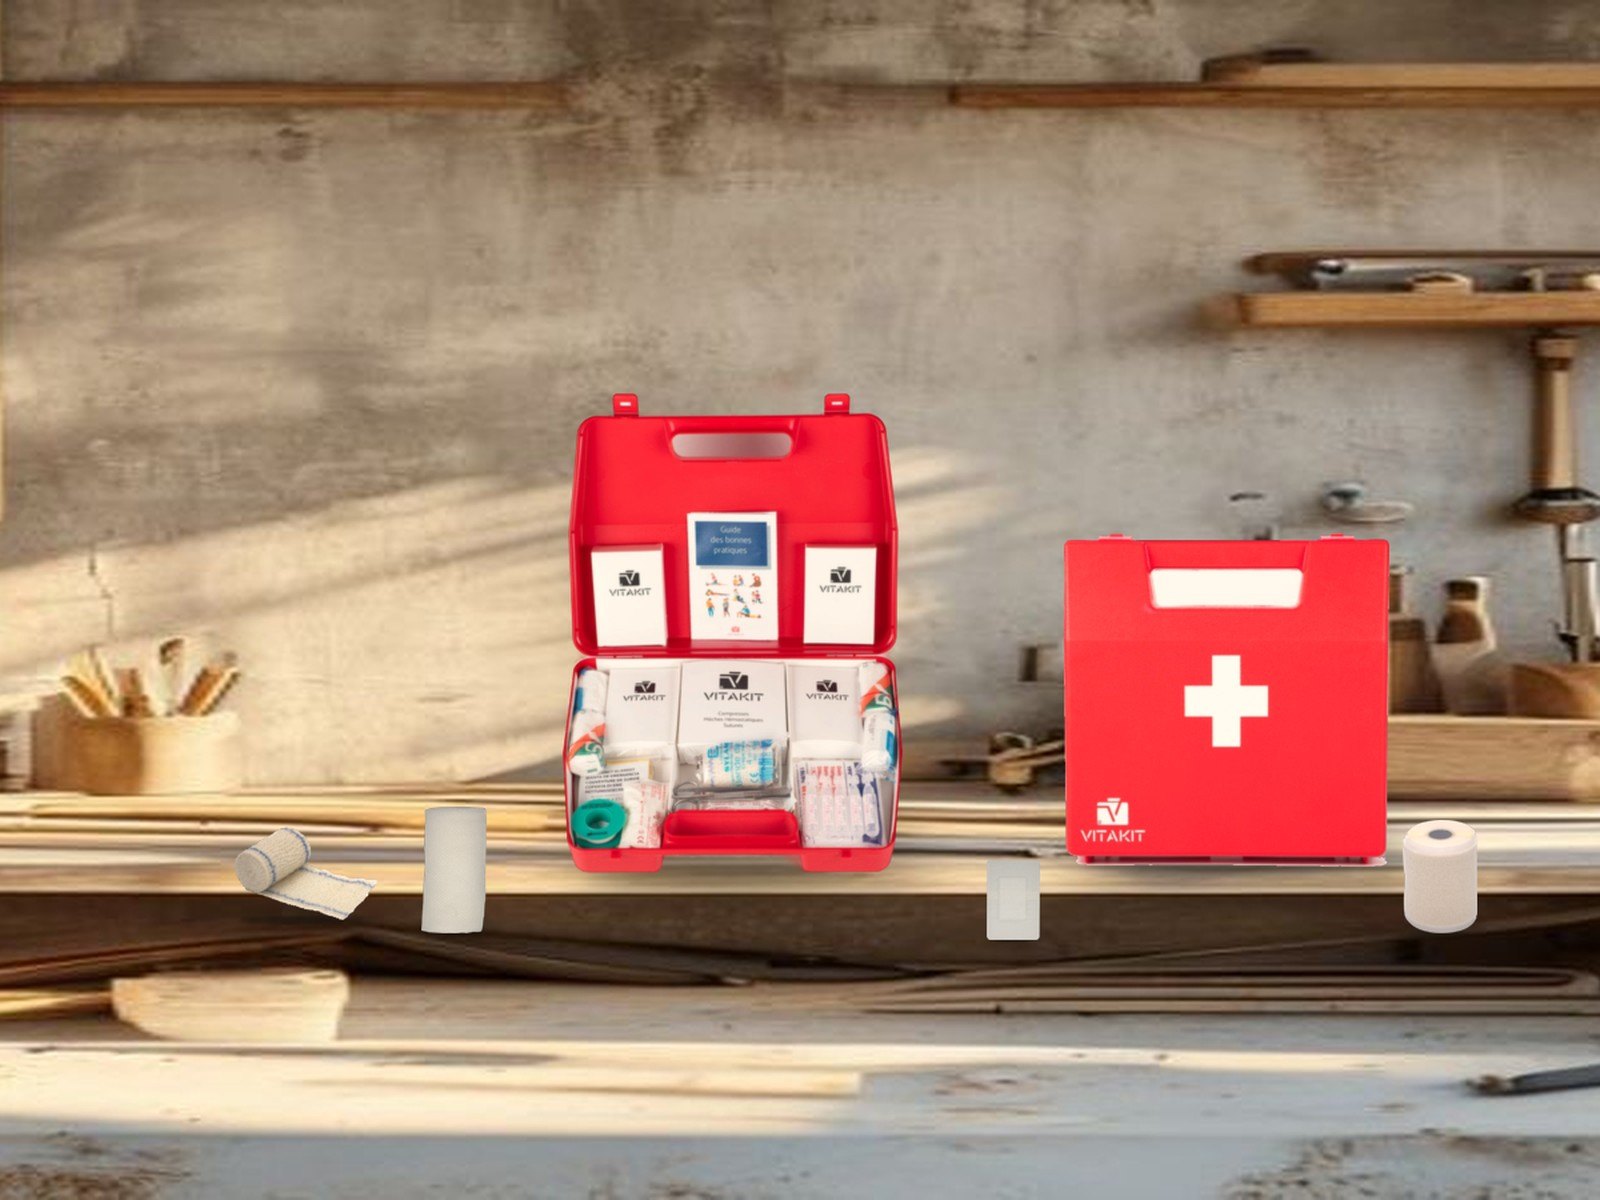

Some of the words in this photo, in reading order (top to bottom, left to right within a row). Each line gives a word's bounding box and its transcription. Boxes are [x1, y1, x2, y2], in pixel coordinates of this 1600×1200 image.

[720, 525, 741, 534] Guide
[710, 536, 723, 544] des
[725, 536, 752, 544] bonnes
[713, 546, 748, 555] pratiques
[609, 587, 652, 597] VITAKIT
[819, 584, 862, 594] VITAKIT
[623, 694, 666, 702] VITAKIT
[703, 691, 765, 702] VITAKIT
[806, 692, 849, 702] VITAKIT
[1080, 829, 1146, 843] VITAKIT
